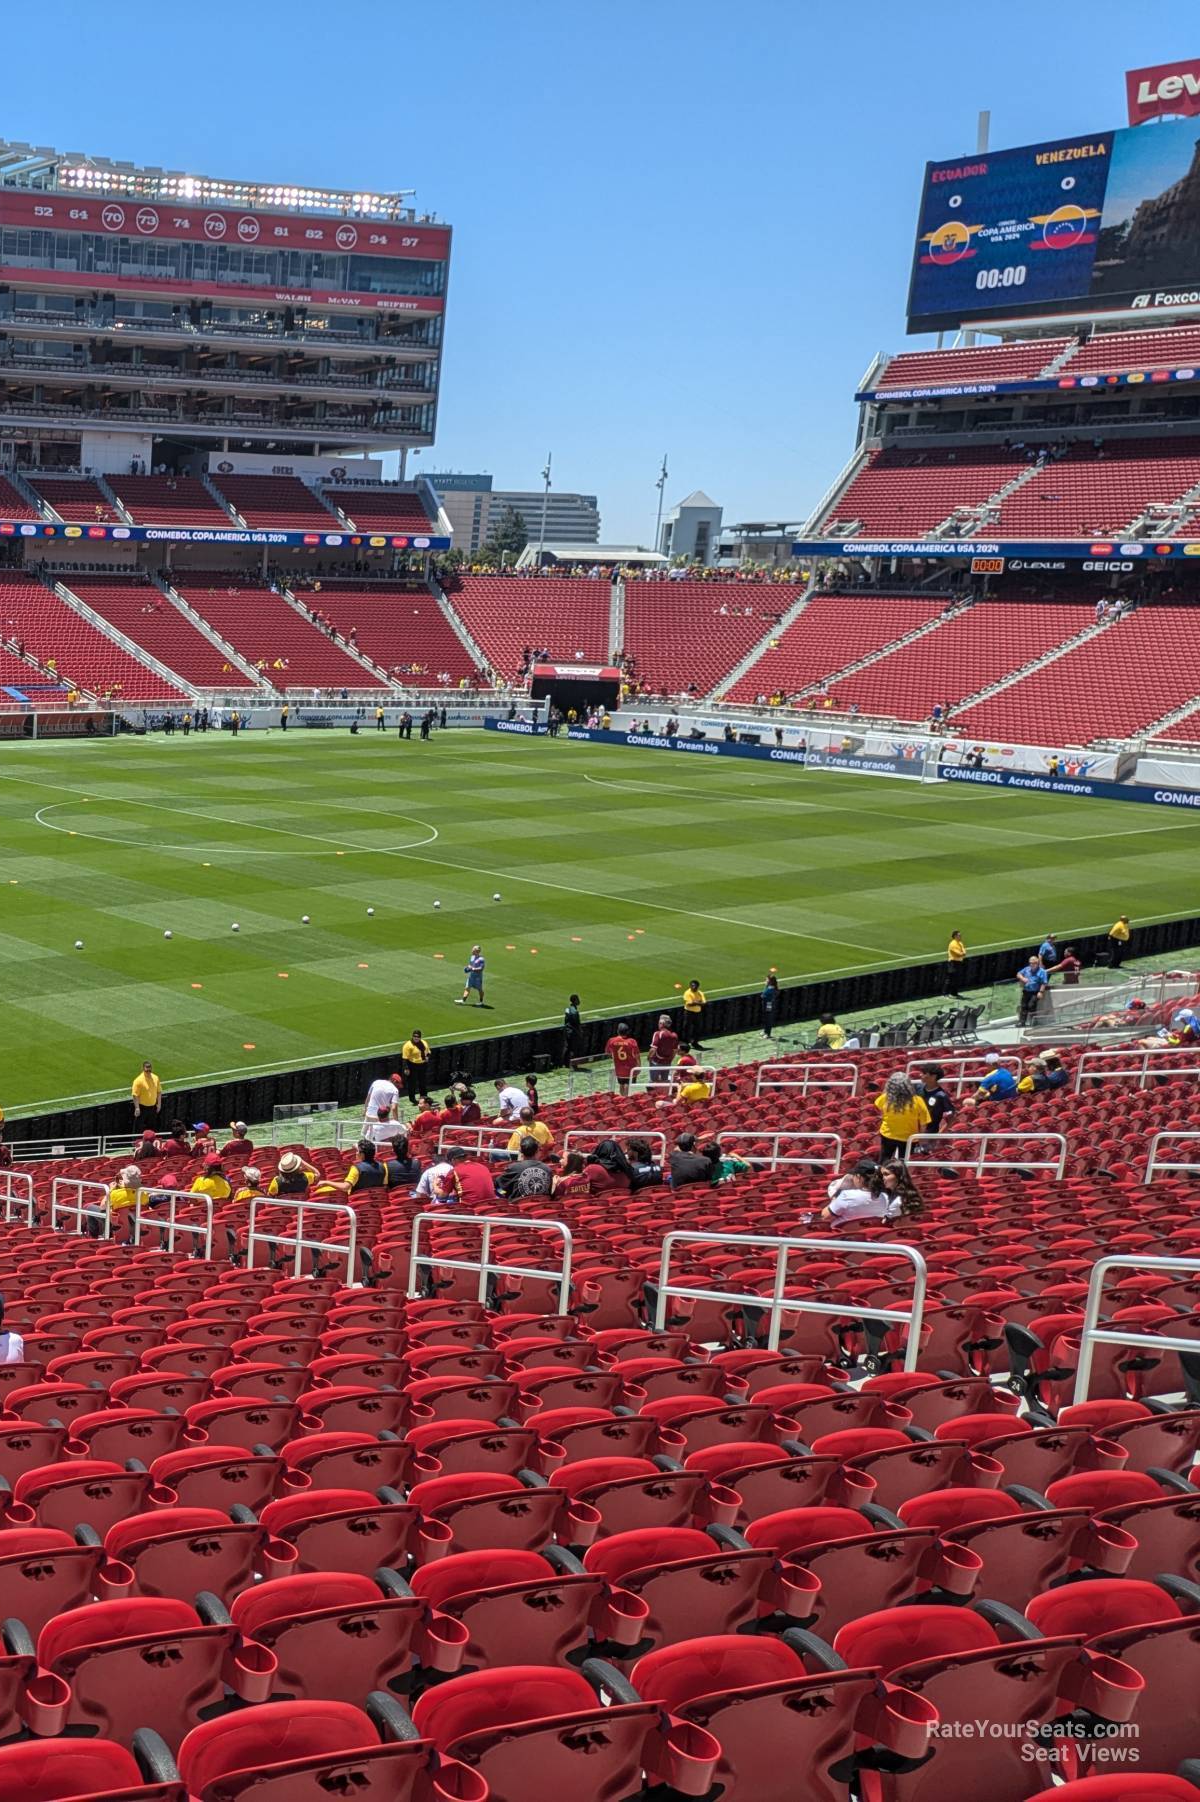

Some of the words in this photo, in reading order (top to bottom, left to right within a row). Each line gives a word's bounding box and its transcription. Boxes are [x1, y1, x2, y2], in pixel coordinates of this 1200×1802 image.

[1035, 143, 1106, 166] VENEZUELA
[931, 163, 988, 183] ECUADOR
[34, 206, 53, 217] 52
[69, 209, 89, 220] 64
[104, 212, 122, 223] 70
[138, 215, 157, 226] 73
[172, 218, 191, 228] 74
[206, 221, 225, 231] 79
[239, 224, 258, 234] 80
[274, 227, 289, 236] 81
[305, 229, 324, 239] 82
[338, 232, 355, 241] 87
[976, 265, 1027, 290] 00:00
[275, 293, 312, 302] WALSH
[1155, 292, 1200, 306] Foxco
[145, 530, 193, 540] CONMEBOL
[192, 531, 215, 541] COPA
[214, 532, 251, 542] AMERICA
[252, 533, 267, 542] USA
[268, 533, 288, 543] 2024
[842, 543, 890, 553] CONMEBOL
[890, 543, 914, 553] COPA
[914, 543, 955, 553] AMERICA
[957, 543, 975, 554] USA
[975, 543, 999, 553] 2024
[973, 560, 1001, 571] 00:00
[1023, 561, 1065, 570] LEXUS
[1082, 561, 1134, 572] GEICO
[497, 721, 533, 733] CONMEBOL
[568, 731, 590, 739] empre
[626, 735, 671, 748] CONMEBOL
[676, 740, 704, 751] Dream
[704, 743, 719, 755] big
[849, 760, 861, 768] en
[862, 759, 896, 772] grande
[942, 767, 1003, 784] CONMEBOL
[1007, 776, 1050, 789] Acredite
[1052, 782, 1093, 794] sempre
[1154, 790, 1200, 806] CONME
[617, 1046, 628, 1060] 6
